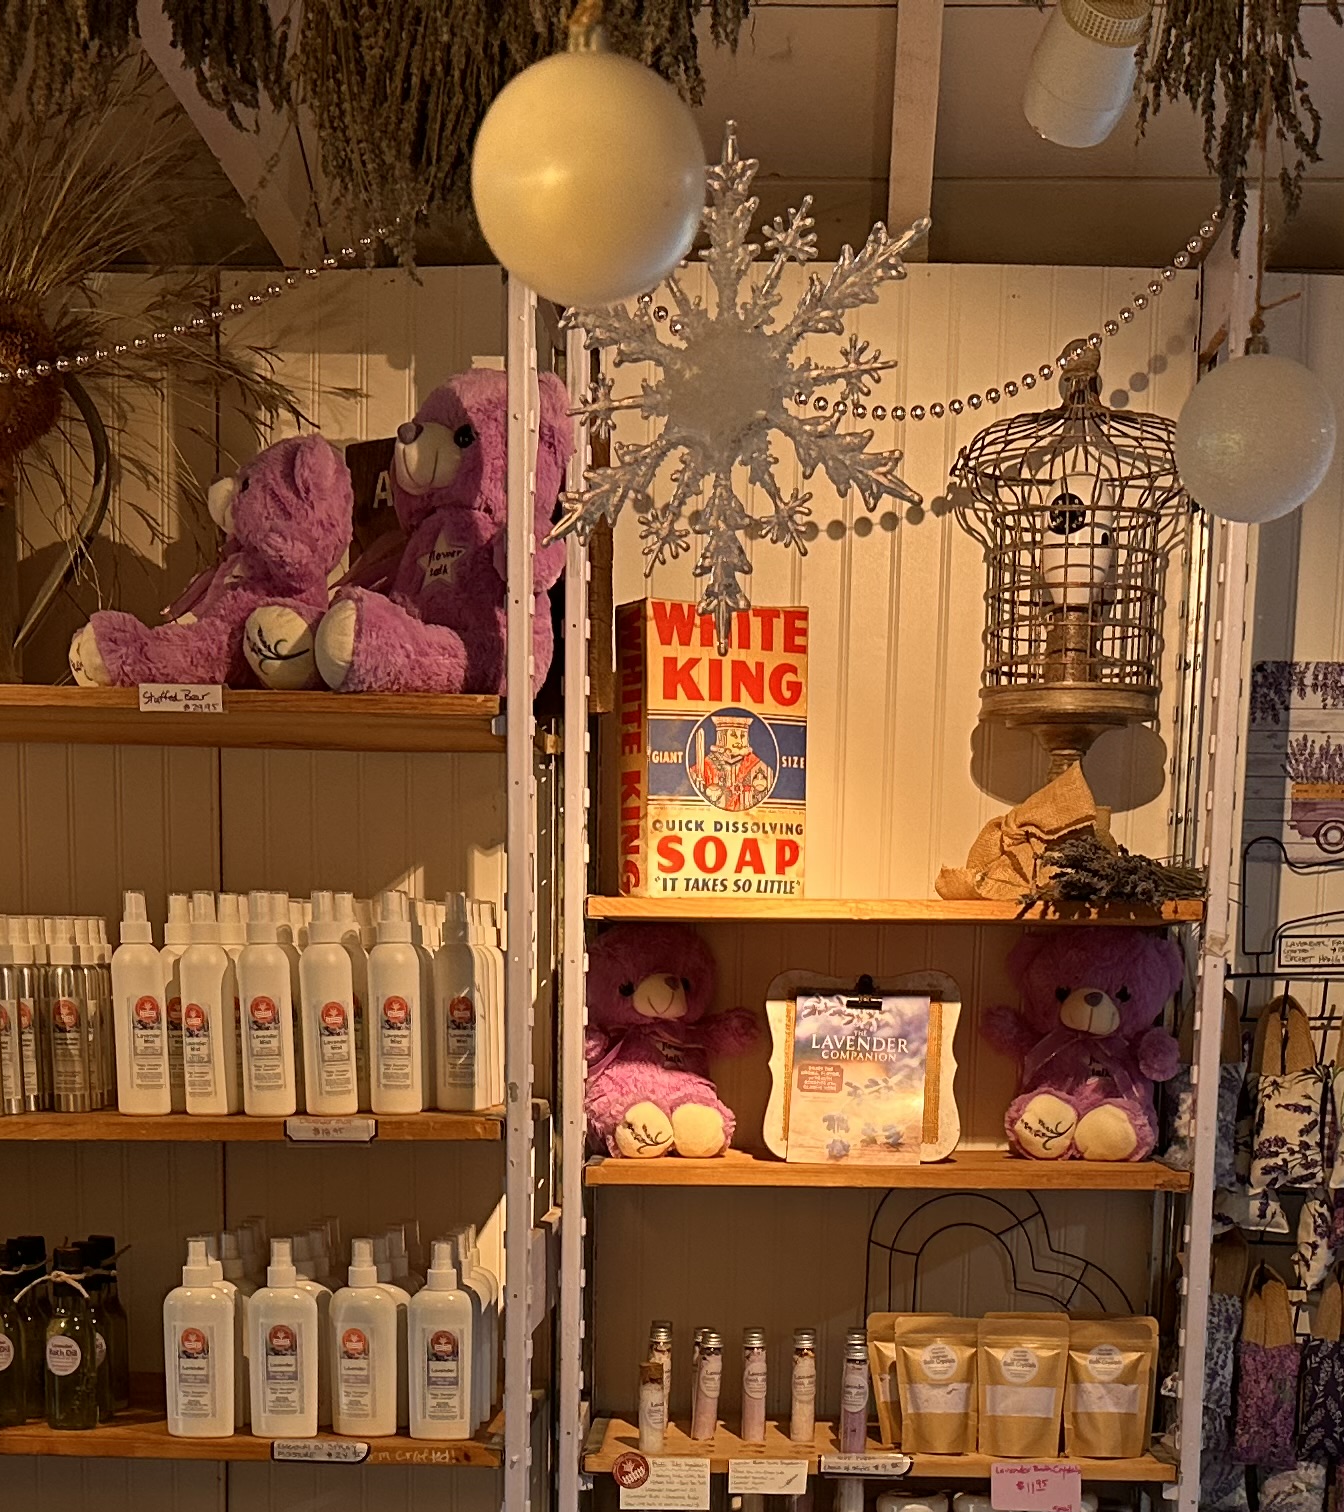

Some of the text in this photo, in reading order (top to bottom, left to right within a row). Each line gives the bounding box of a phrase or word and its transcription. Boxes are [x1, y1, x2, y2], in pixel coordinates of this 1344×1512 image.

[663, 657, 802, 707] KING
[181, 689, 210, 701] Bear
[652, 751, 805, 769] GIANT SIZE
[620, 770, 641, 894] KING
[651, 819, 804, 836] QUICK DISSOLVING
[656, 834, 800, 875] SOAP
[685, 877, 728, 893] TAKES
[733, 878, 752, 893] SO
[811, 1033, 909, 1053] LAVENDER
[821, 1049, 897, 1062] COMPANION
